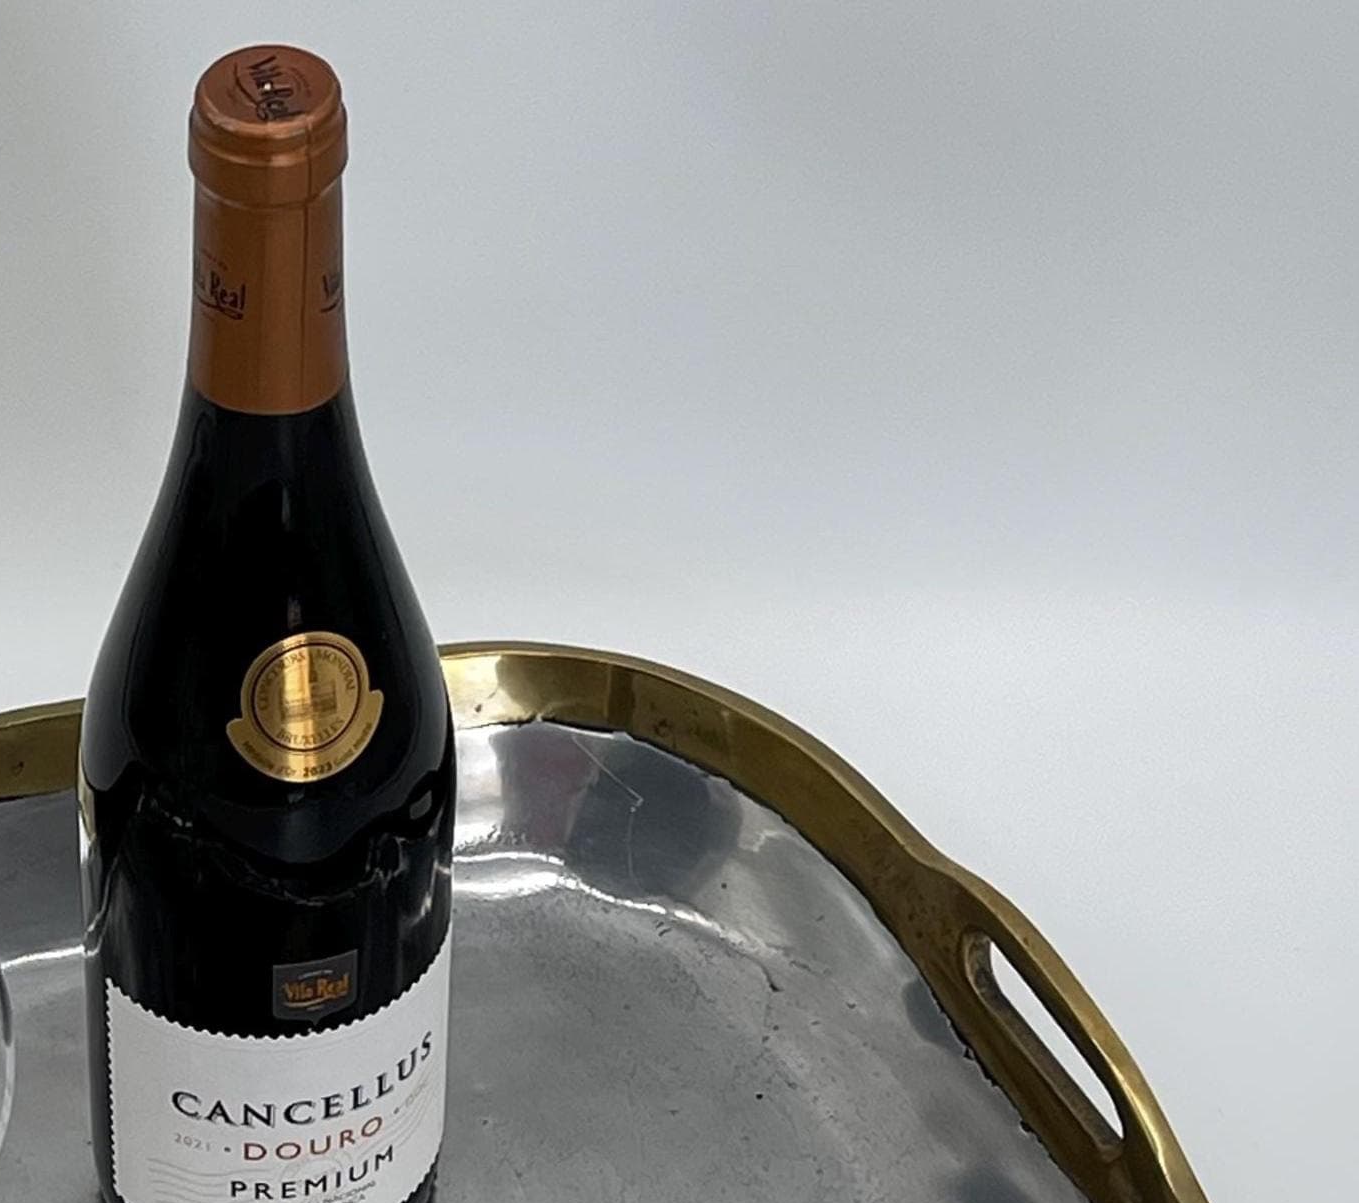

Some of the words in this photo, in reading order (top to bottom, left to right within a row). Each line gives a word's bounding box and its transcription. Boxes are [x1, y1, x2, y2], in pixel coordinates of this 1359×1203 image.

[302, 761, 333, 778] 2023
[317, 973, 350, 999] Real
[171, 1031, 432, 1129] CANCELLUS
[173, 1132, 211, 1152] 2021
[243, 1116, 384, 1161] DOURO
[230, 1145, 395, 1201] PREMIUM
